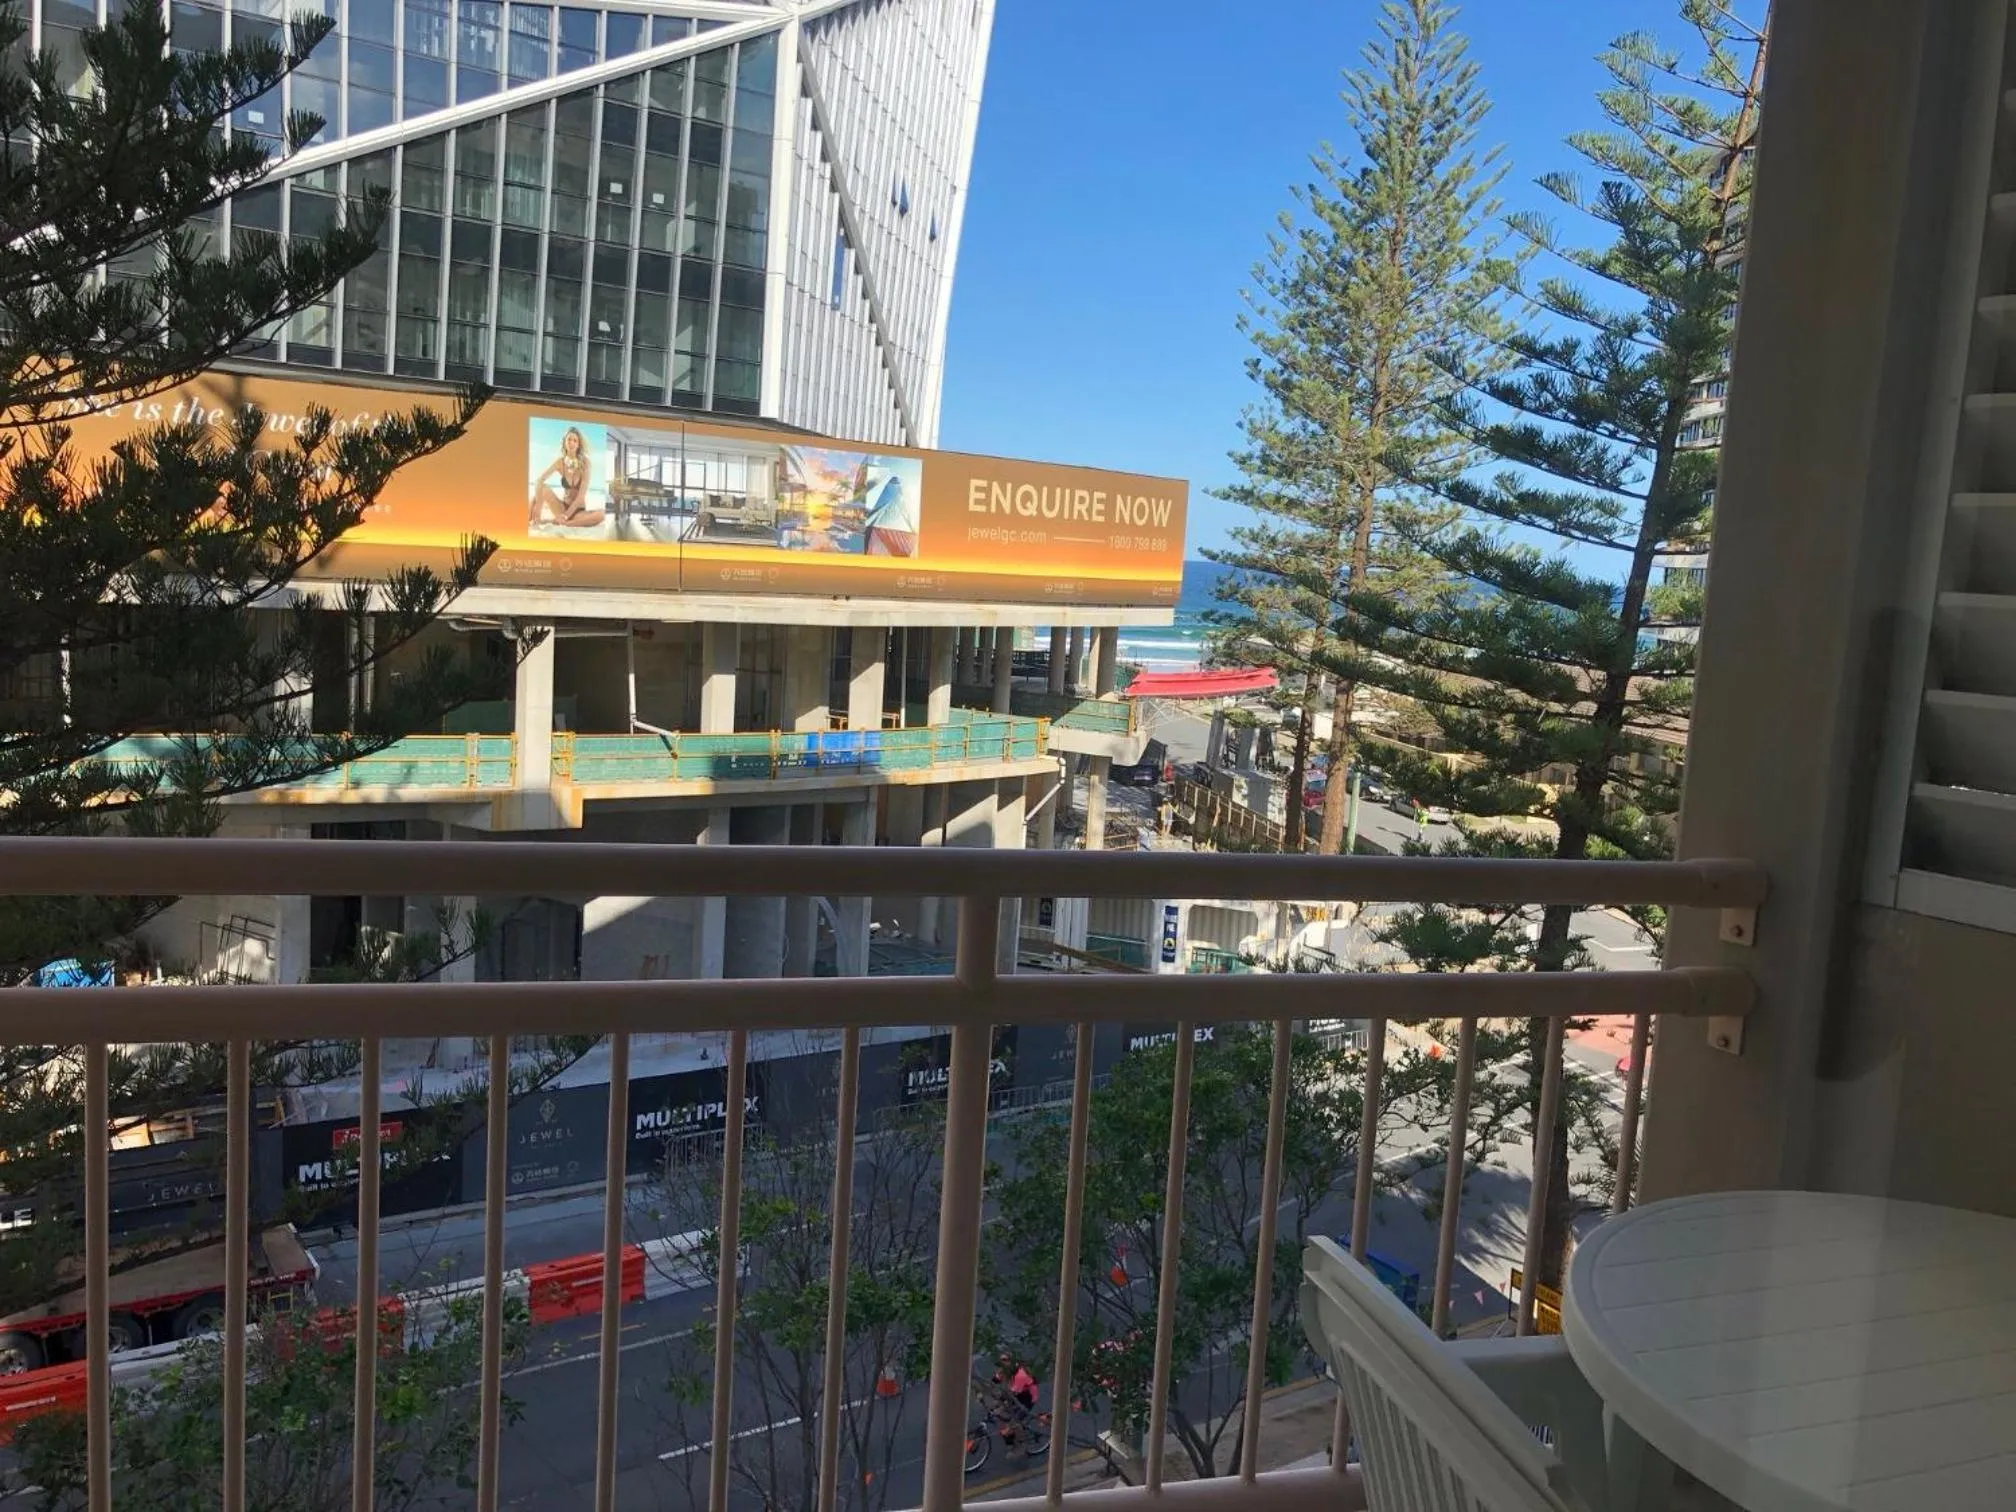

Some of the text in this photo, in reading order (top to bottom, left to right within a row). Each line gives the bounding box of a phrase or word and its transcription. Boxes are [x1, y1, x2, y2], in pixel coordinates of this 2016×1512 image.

[171, 396, 225, 427] the
[967, 478, 1172, 528] ENQUIRE NOW
[967, 525, 1047, 546] jewelgc.com
[636, 1096, 759, 1130] MULTIPLX
[519, 1127, 575, 1145] JEWEL
